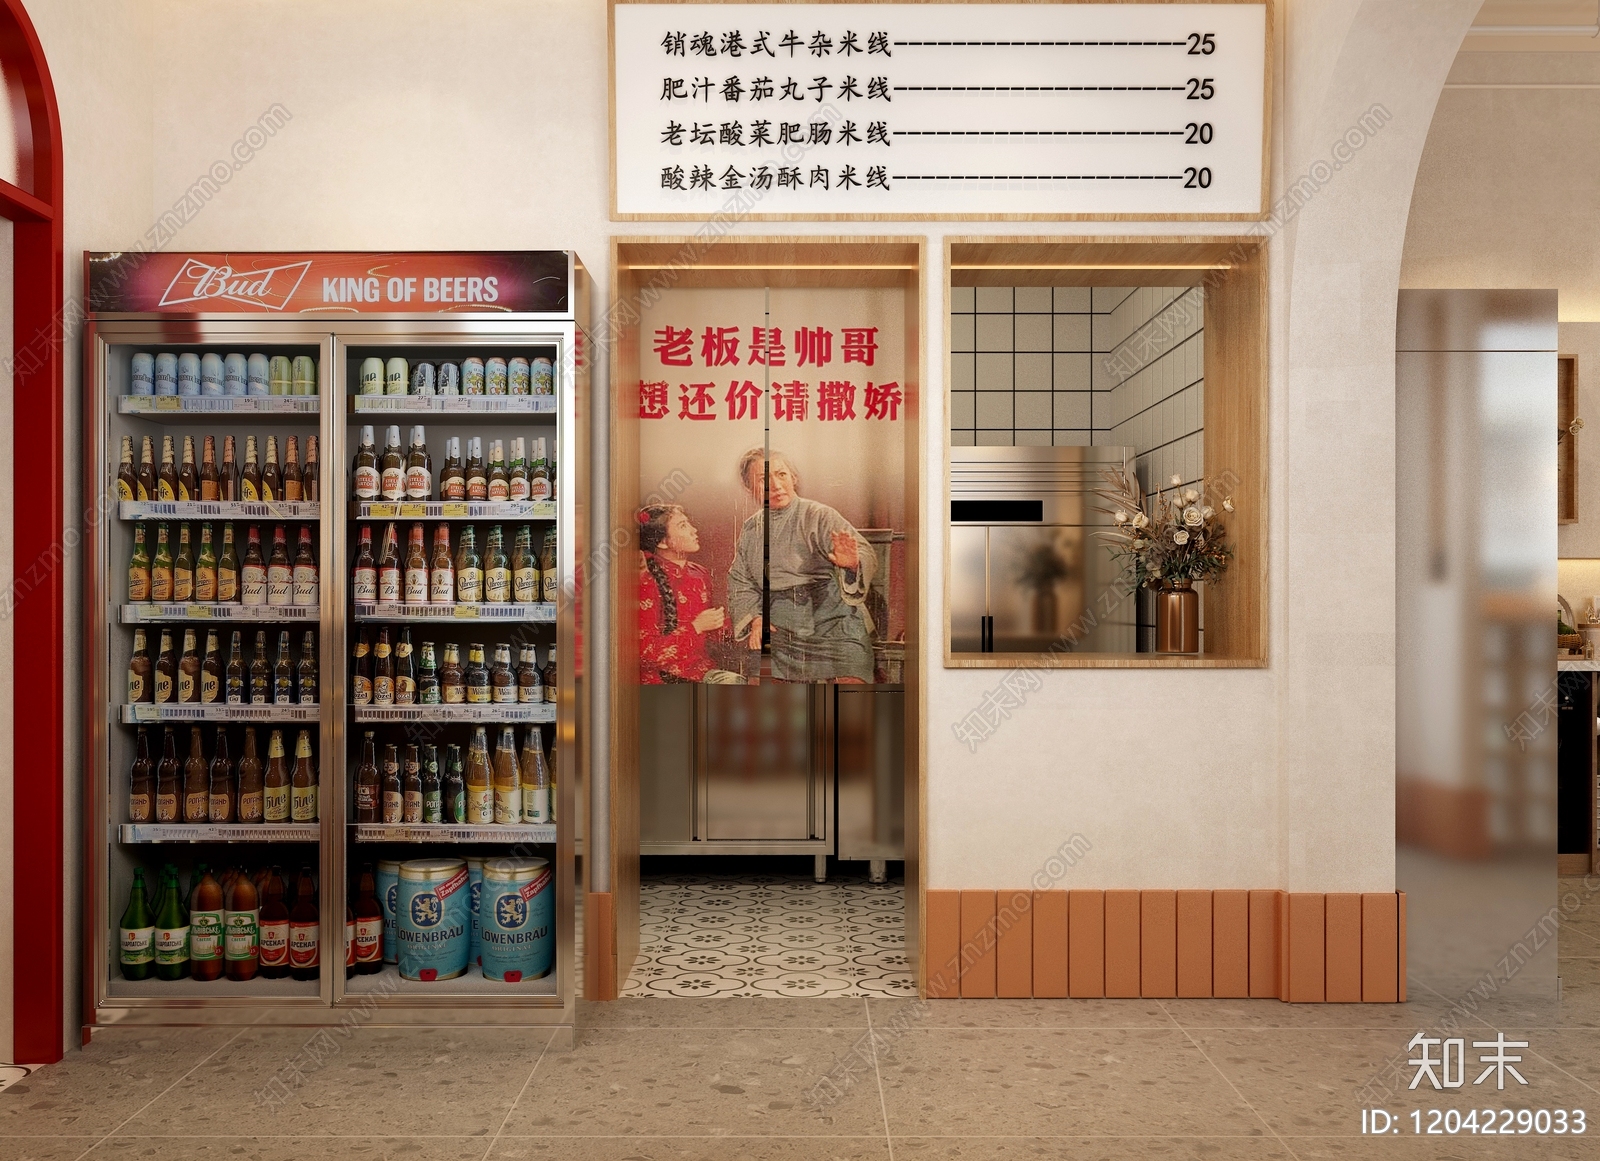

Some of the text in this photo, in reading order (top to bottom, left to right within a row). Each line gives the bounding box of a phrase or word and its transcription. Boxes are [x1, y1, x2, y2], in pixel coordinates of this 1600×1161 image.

[661, 30, 1216, 58] 销魂港式牛杂米线 25
[660, 75, 1215, 103] 肥汁番茄丸子米线 25
[660, 119, 1213, 147] 老坛酸菜肥肠米线 20
[660, 164, 1212, 191] 酸辣金汤酥肉米线 20
[187, 266, 275, 298] Bud
[322, 276, 499, 303] KING OF BEERS
[653, 325, 879, 368] 老板是帅哥
[638, 380, 907, 421] 想还价请撒娇
[397, 925, 465, 943] LÖWENBRÄU
[481, 925, 548, 944] LÖWENBRÄU
